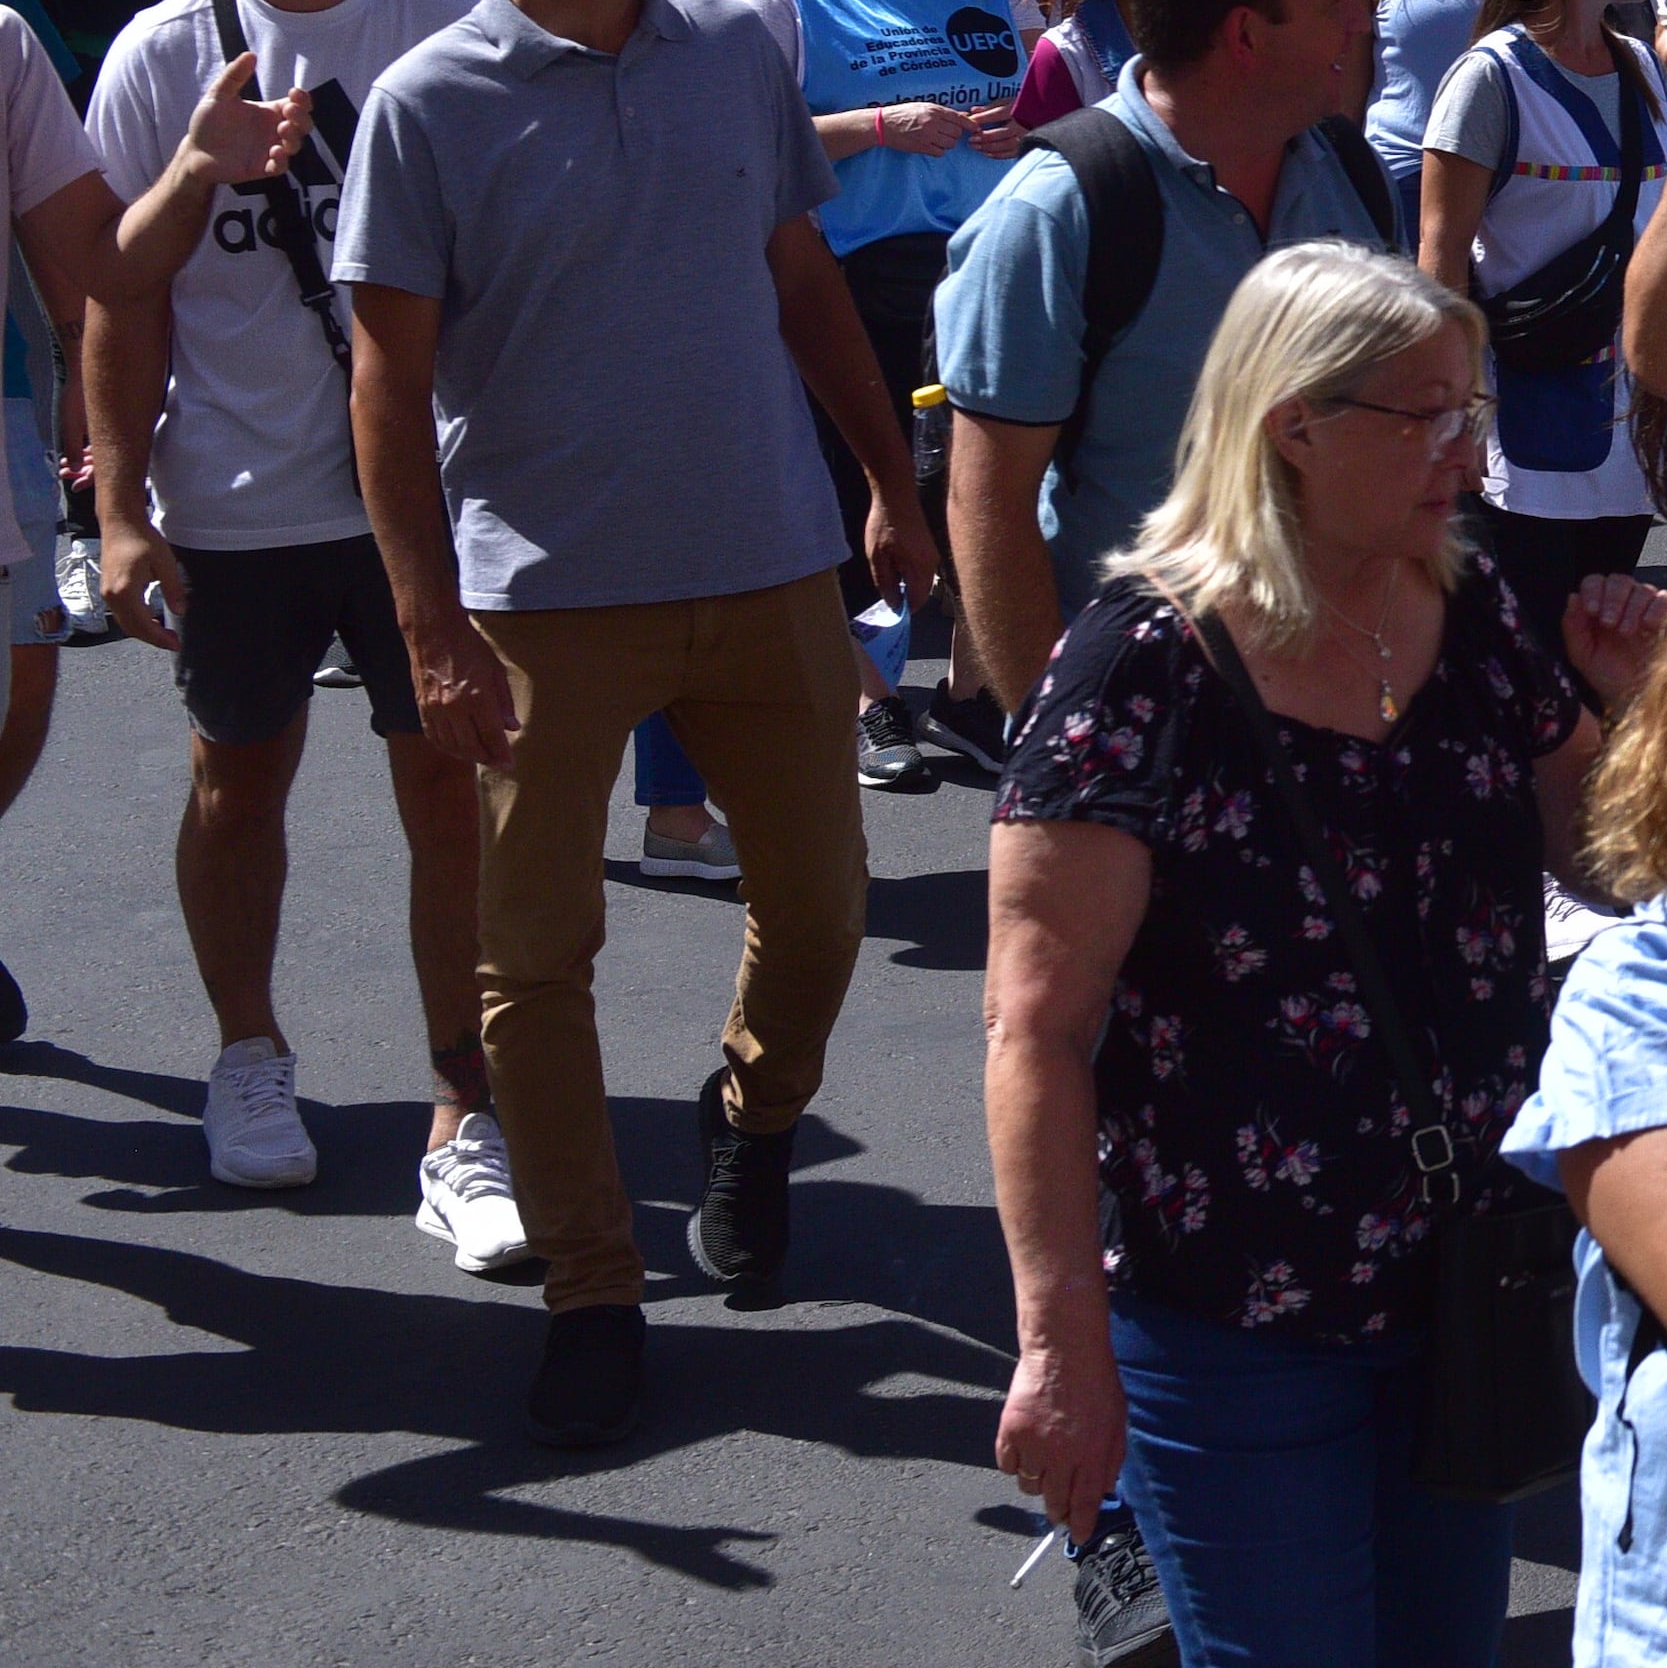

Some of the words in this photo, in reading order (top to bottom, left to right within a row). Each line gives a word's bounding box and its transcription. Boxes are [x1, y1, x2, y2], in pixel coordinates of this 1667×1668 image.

[880, 26, 920, 38] Unión
[922, 25, 938, 35] de
[951, 30, 1017, 53] UEPC
[864, 35, 946, 53] Educadores
[850, 58, 868, 71] de
[871, 55, 886, 66] la
[889, 46, 952, 62] Provincia
[878, 65, 897, 78] de
[900, 56, 958, 73] Córdoba
